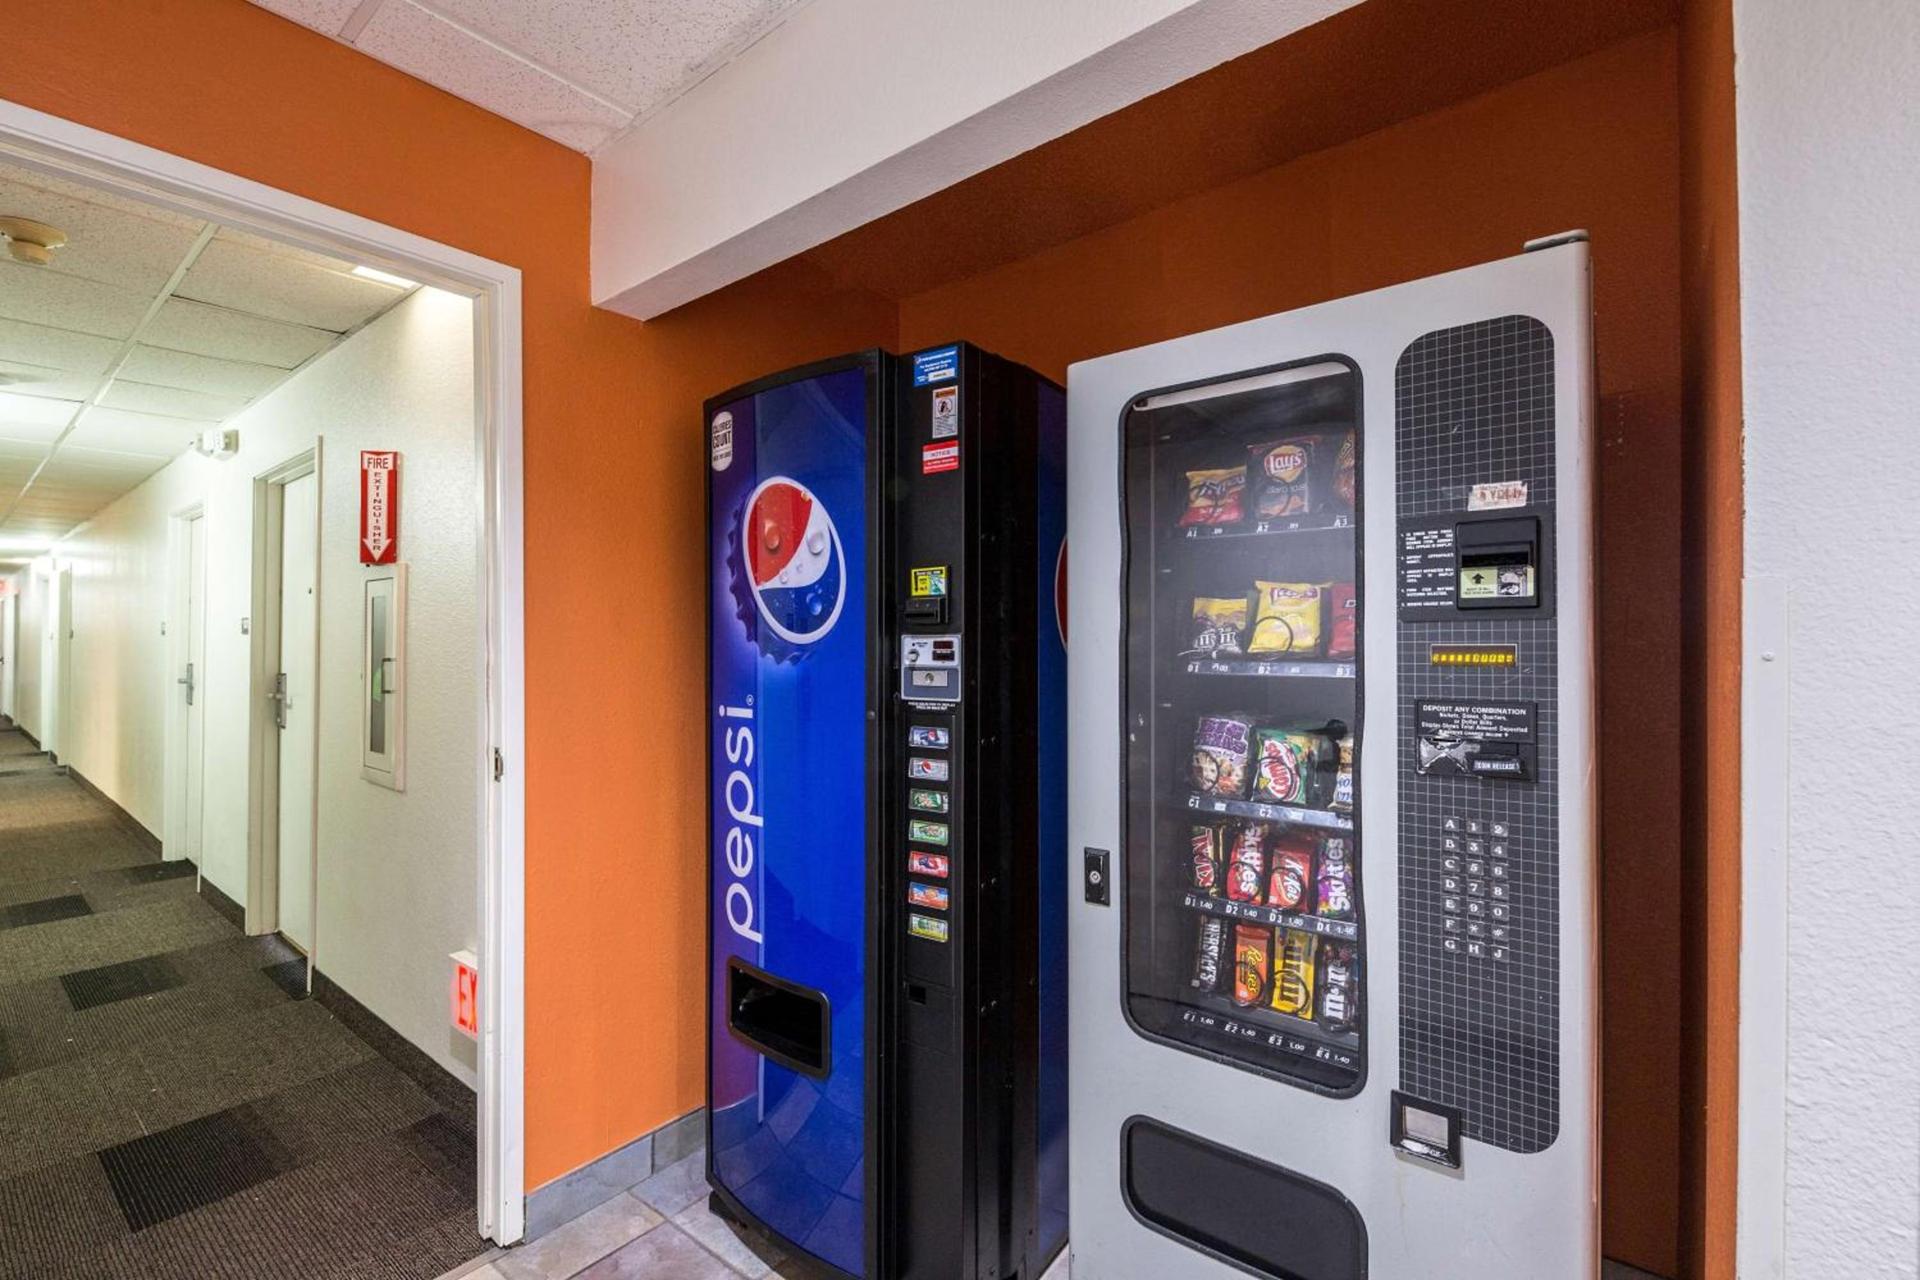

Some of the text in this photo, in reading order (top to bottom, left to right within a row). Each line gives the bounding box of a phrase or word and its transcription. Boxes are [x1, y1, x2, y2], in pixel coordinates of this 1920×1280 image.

[713, 431, 731, 449] COUNT
[367, 457, 389, 469] FIRE
[373, 471, 382, 551] EXTINGUISHER
[1422, 704, 1527, 715] DEPOSIT ANY COMBINATION
[1492, 761, 1516, 770] RELEASE
[1259, 808, 1272, 818] C2
[719, 704, 764, 944] pepsi
[1445, 819, 1502, 834] A 1 2
[1446, 840, 1502, 854] B 3 4
[1191, 827, 1215, 888] TWIX
[1326, 838, 1350, 911] Skittles
[1445, 859, 1502, 875] C 5 6
[1446, 880, 1502, 895] D 7 8
[1185, 897, 1196, 907] D1
[1225, 904, 1238, 915] D2
[1243, 909, 1258, 918] 1.40
[1269, 913, 1282, 923] D3
[1316, 922, 1330, 933] D4
[1446, 899, 1502, 916] E 9 0
[1446, 919, 1455, 928] F
[1445, 940, 1501, 958] G H J
[1183, 1013, 1195, 1022] E1
[1200, 1017, 1215, 1025] 1.40
[1224, 1023, 1238, 1034] E2
[1268, 1035, 1282, 1046] E3
[1316, 1049, 1330, 1060] E4
